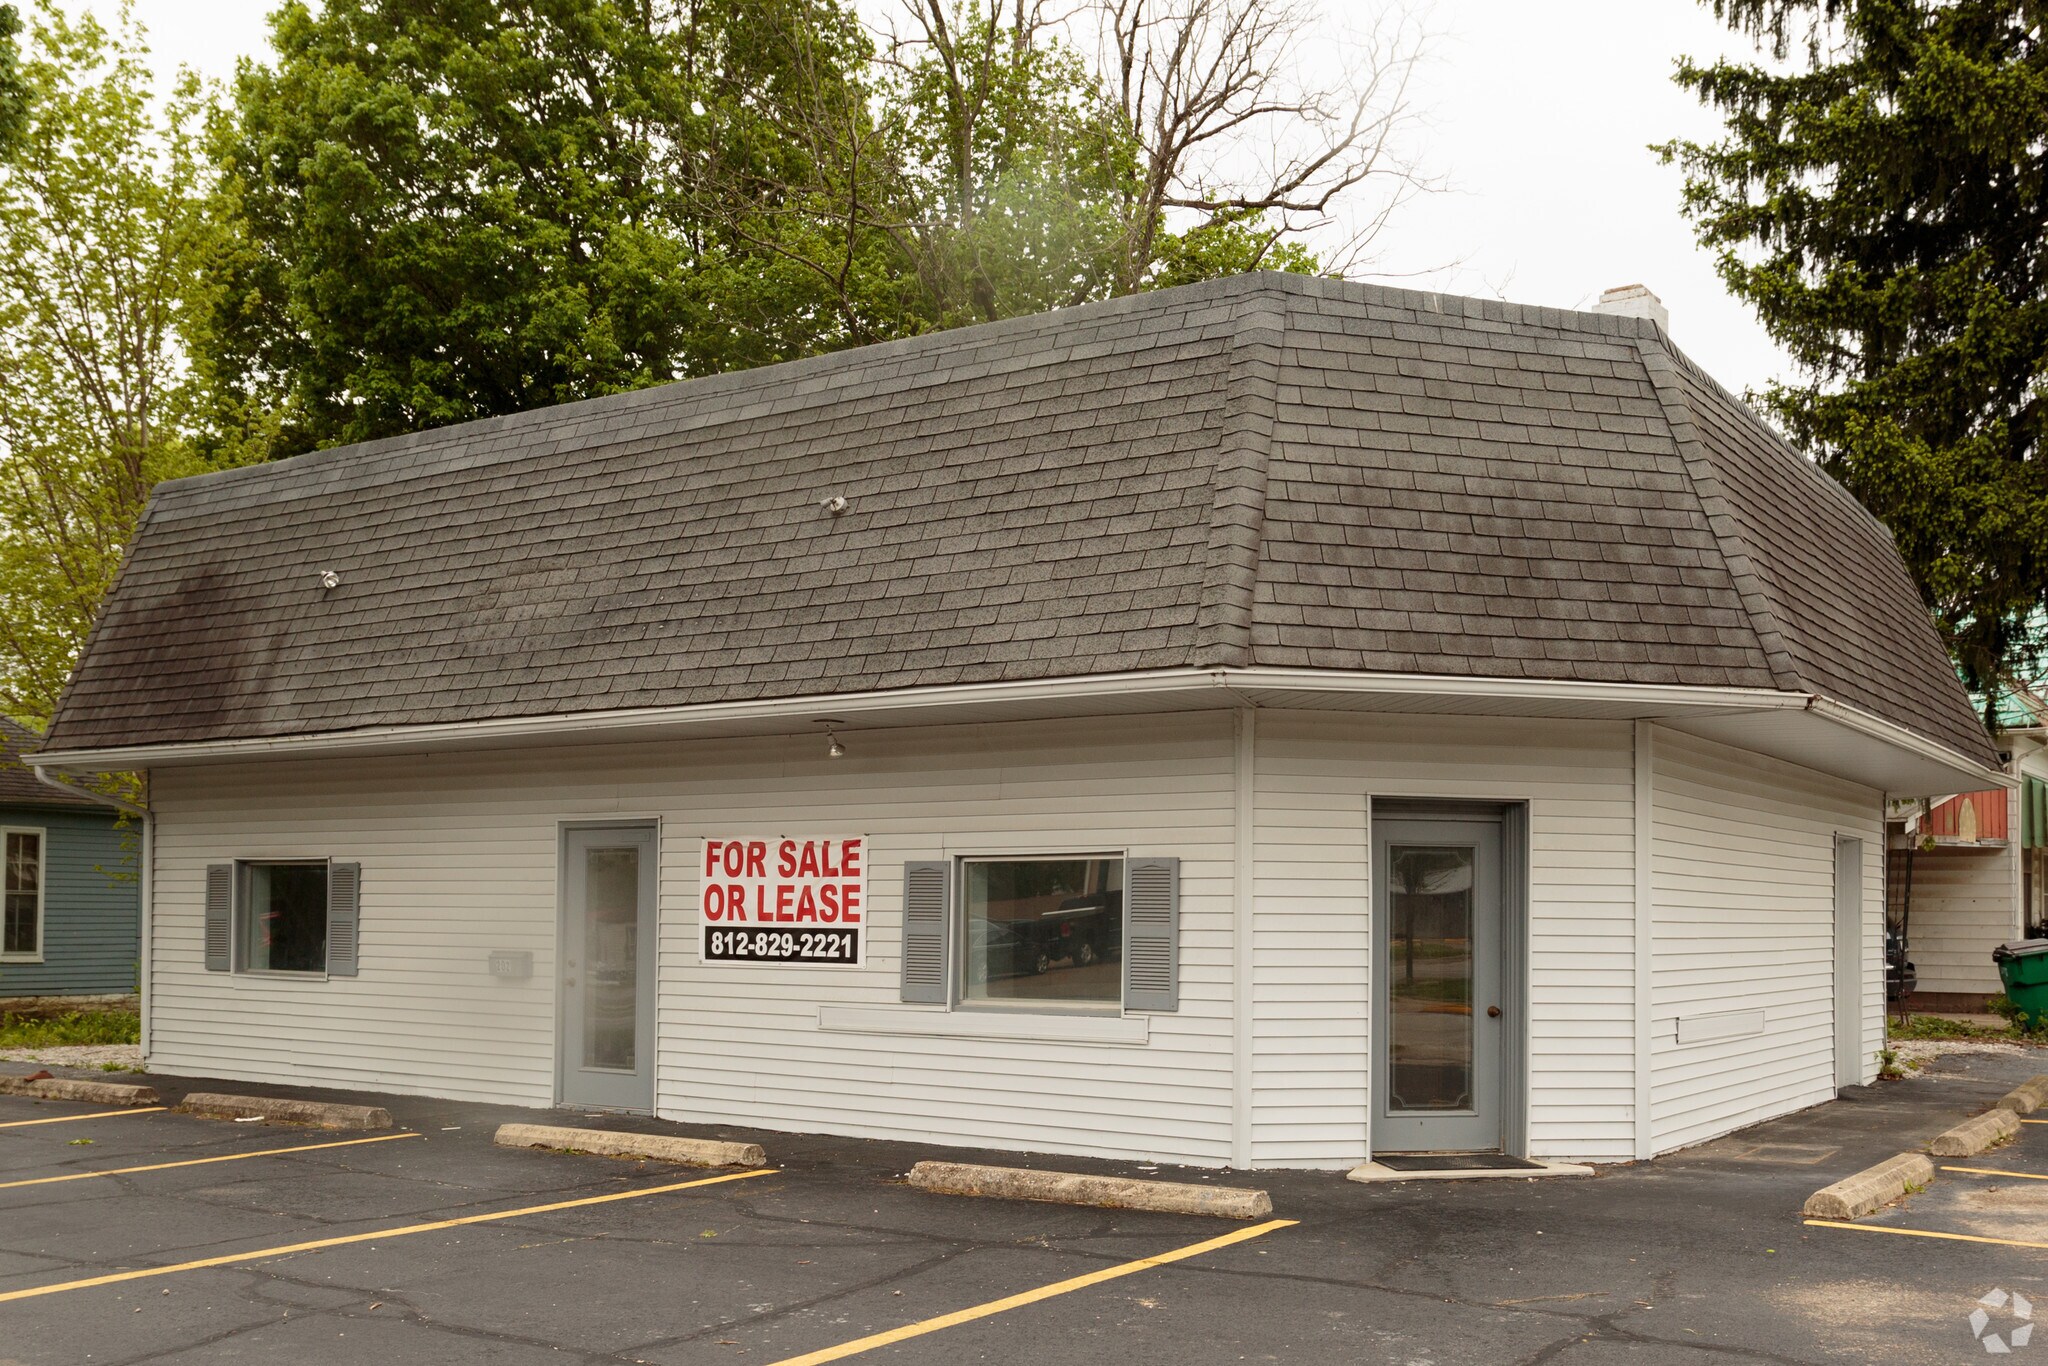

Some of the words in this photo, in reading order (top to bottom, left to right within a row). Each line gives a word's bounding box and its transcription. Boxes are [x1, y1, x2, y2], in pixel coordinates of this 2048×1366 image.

[706, 841, 767, 878] FOR
[778, 839, 862, 878] SALE
[704, 883, 748, 921] OR
[757, 884, 861, 923] LEASE
[711, 931, 851, 958] 812-829-2221
